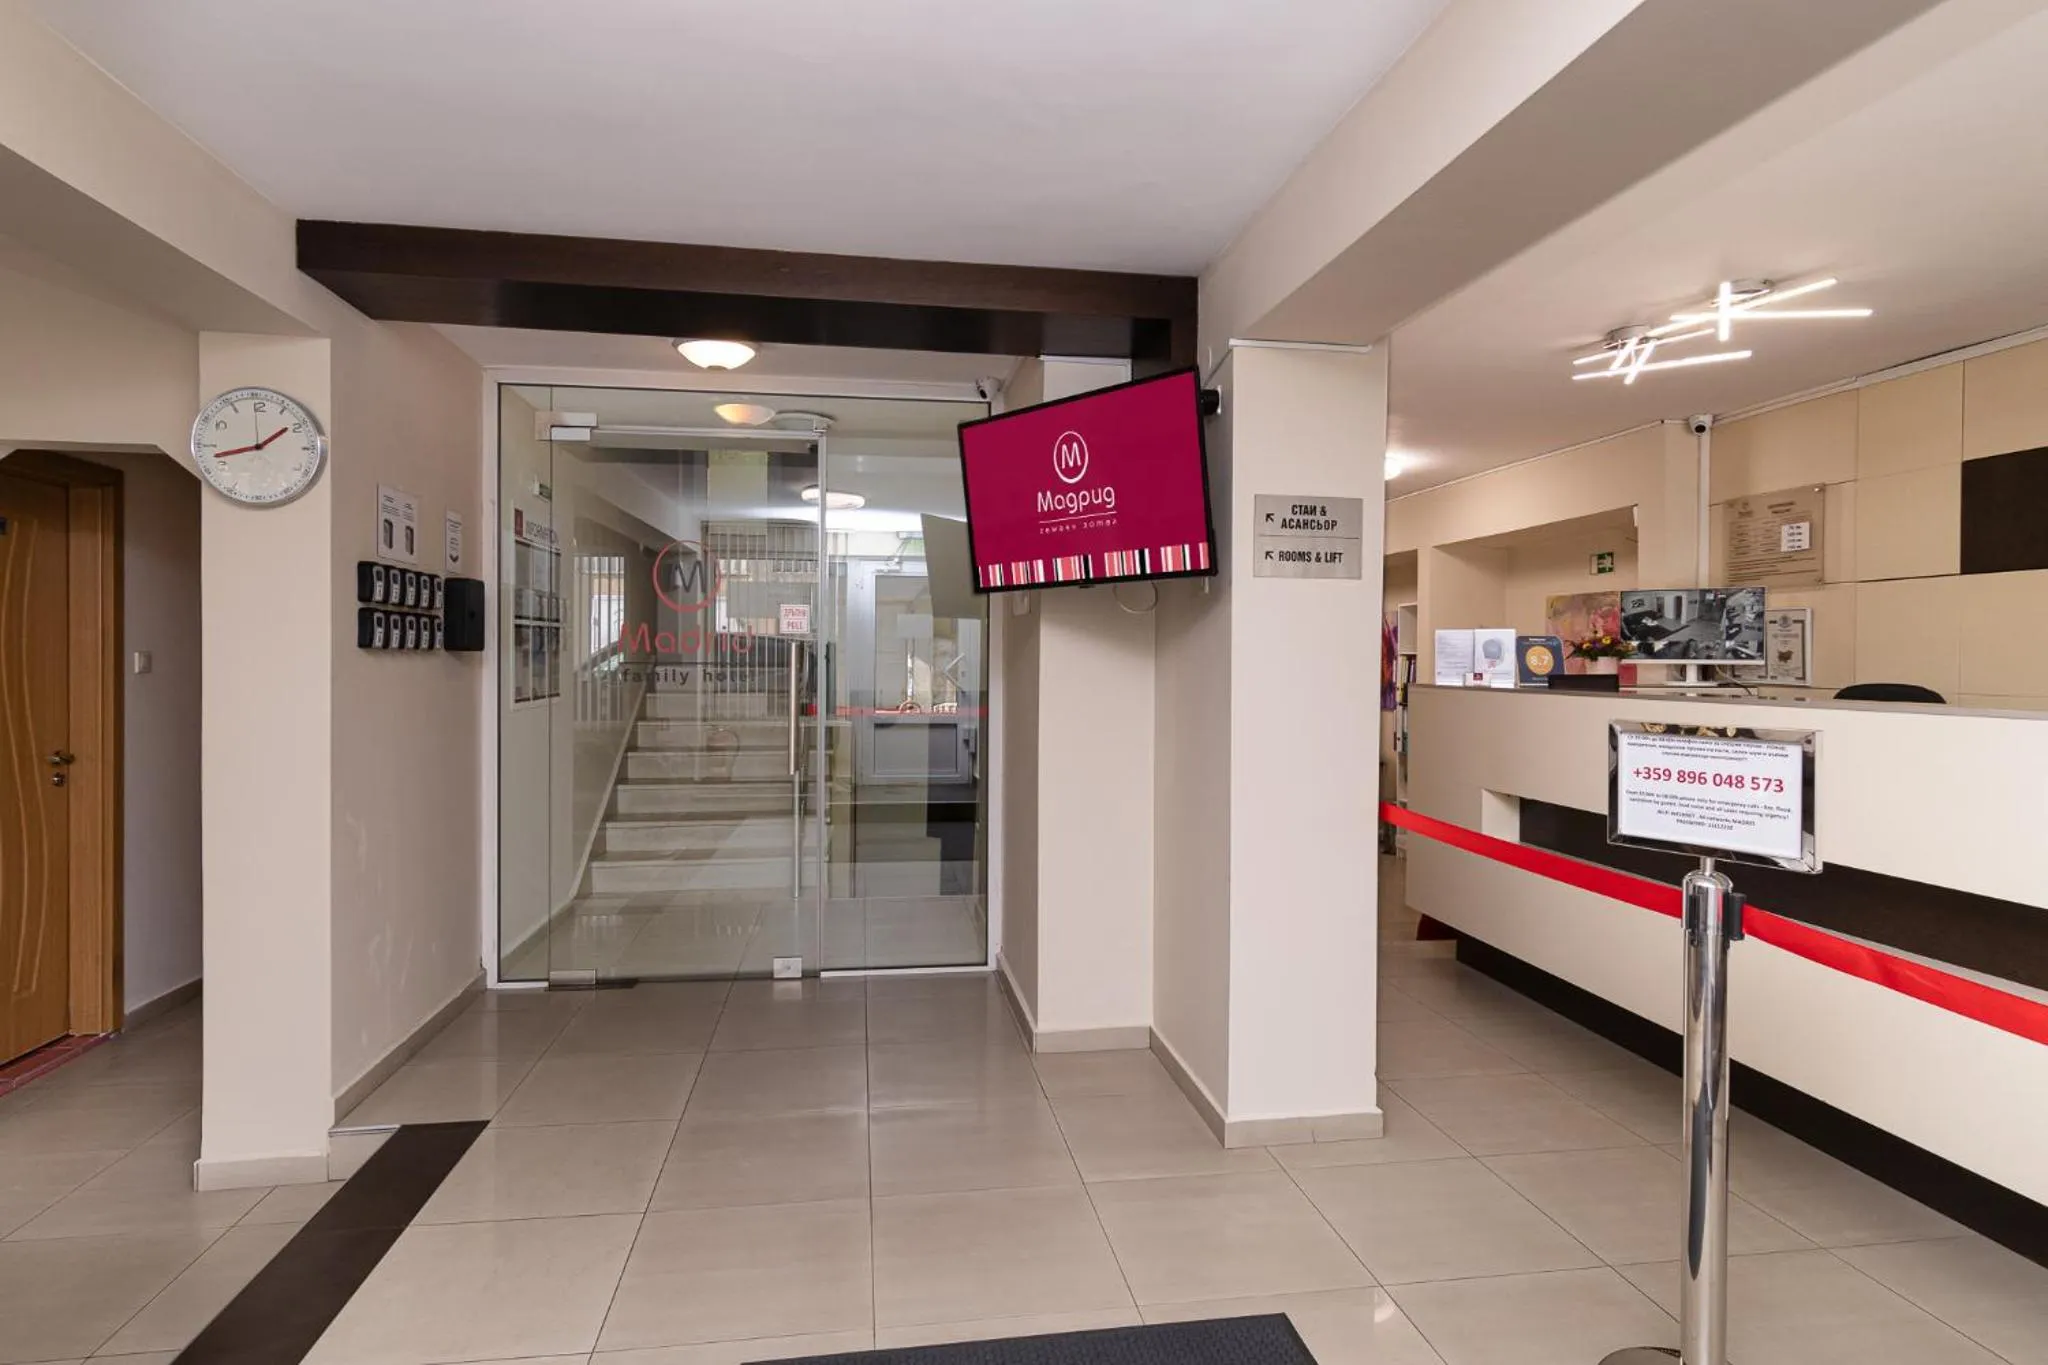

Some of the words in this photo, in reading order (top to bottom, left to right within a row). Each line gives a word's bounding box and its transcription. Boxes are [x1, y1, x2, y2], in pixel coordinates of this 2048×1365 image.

[292, 422, 303, 434] 2
[1291, 504, 1317, 517] СТАИ
[1319, 505, 1328, 517] &
[1280, 517, 1339, 531] АСАНСЬОР
[1278, 550, 1312, 563] ROOMS
[1314, 552, 1323, 564] &
[1325, 552, 1345, 565] LIFT
[617, 620, 755, 656] Madrid
[622, 668, 690, 685] family
[702, 668, 757, 684] hotel
[1632, 766, 1672, 783] +359
[1676, 769, 1708, 786] 896
[1712, 773, 1745, 790] 048
[1750, 776, 1785, 793] 573
